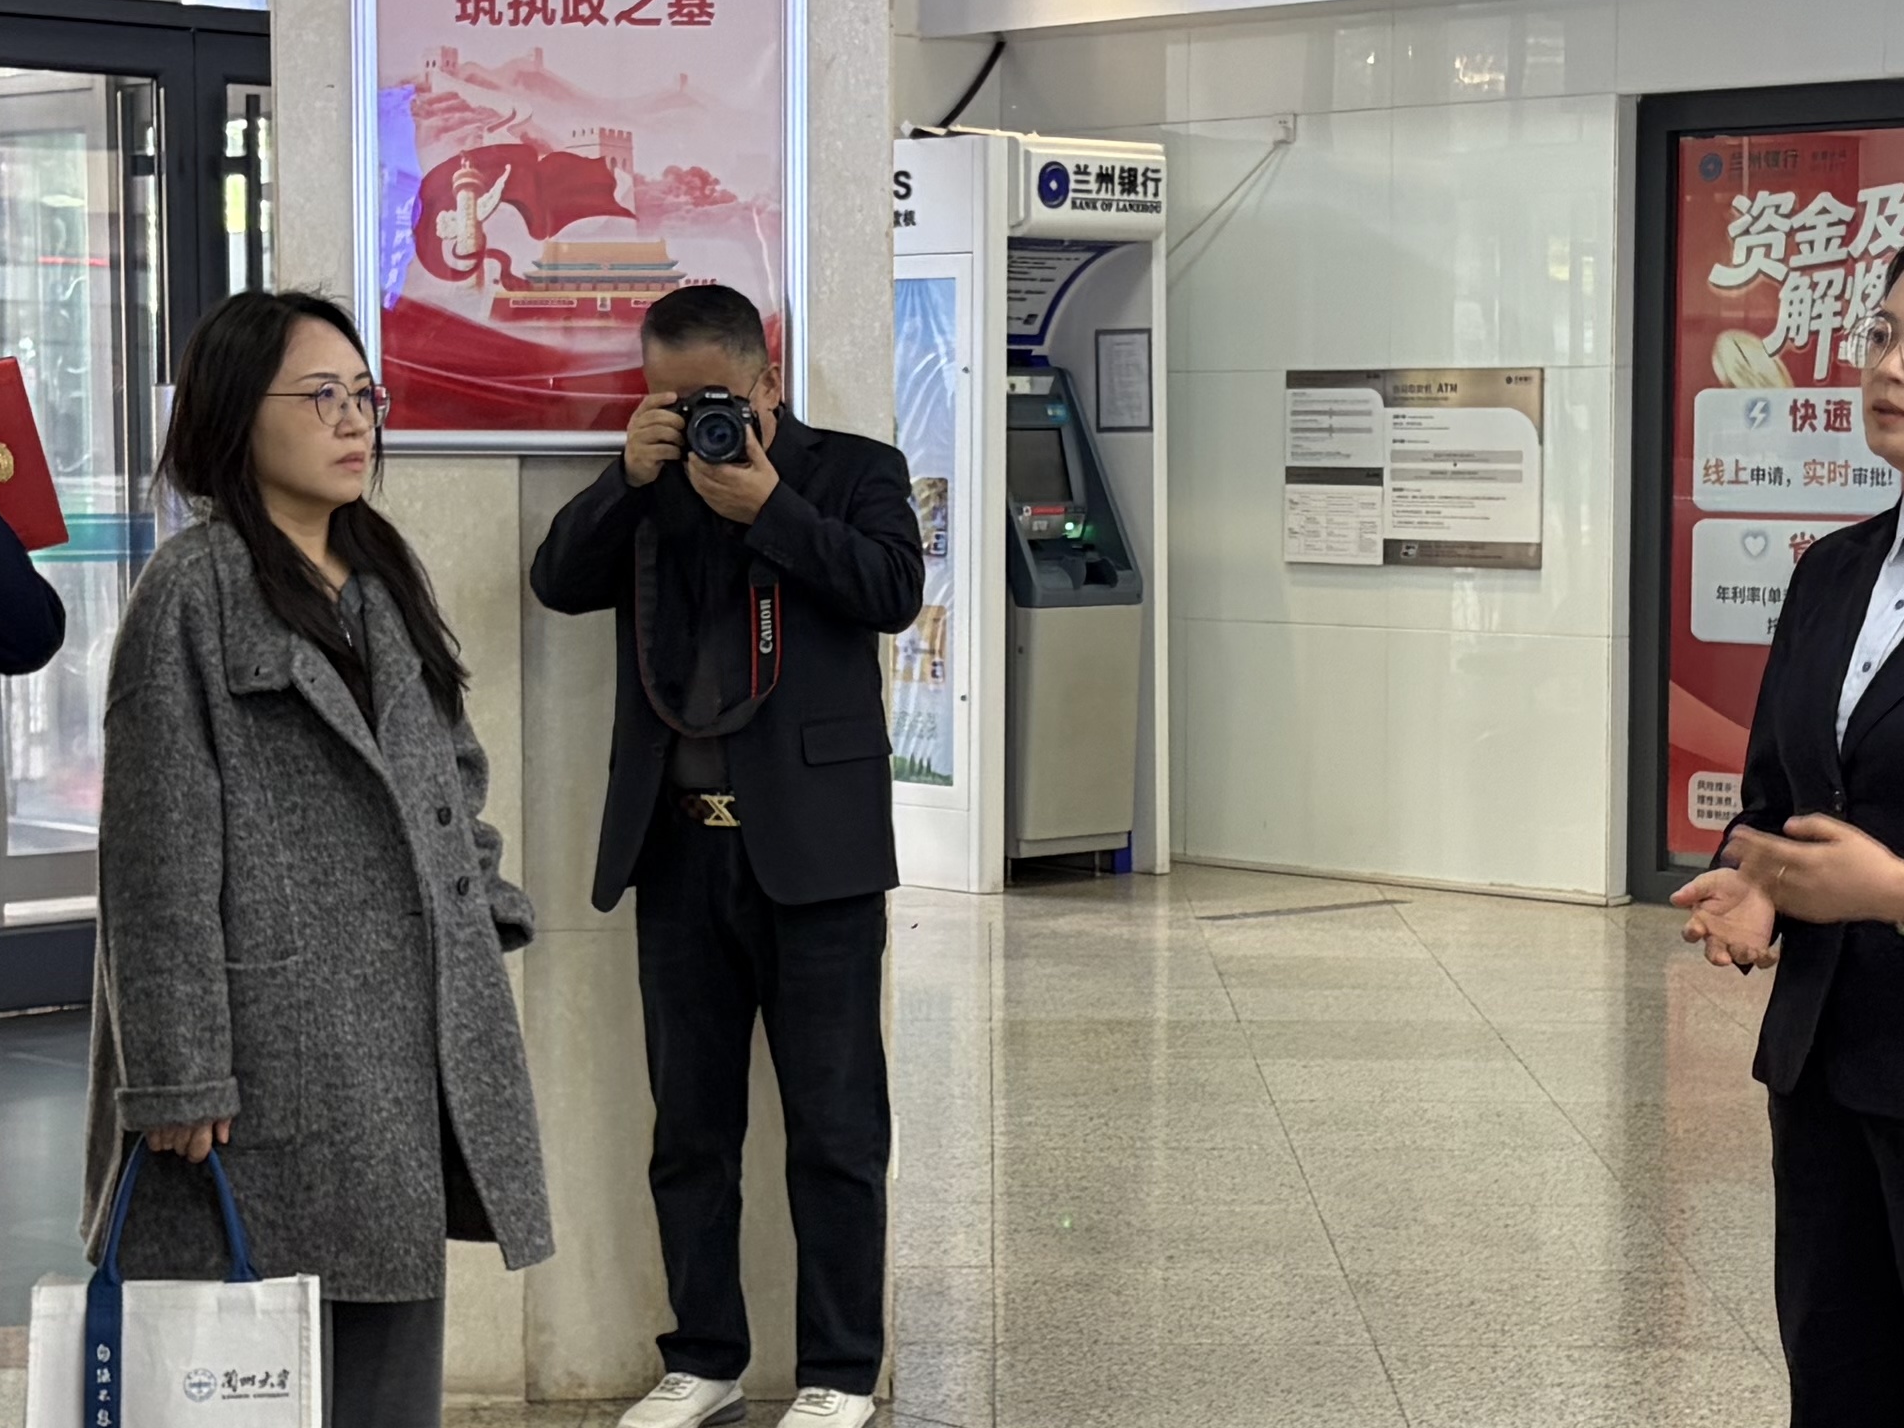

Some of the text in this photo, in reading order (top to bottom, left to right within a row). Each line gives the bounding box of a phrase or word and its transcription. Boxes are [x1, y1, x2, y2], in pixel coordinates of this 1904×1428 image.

[1071, 163, 1163, 199] 兰州银行
[1071, 200, 1098, 211] BANK
[1101, 200, 1114, 212] OF
[1788, 399, 1853, 433] 快速
